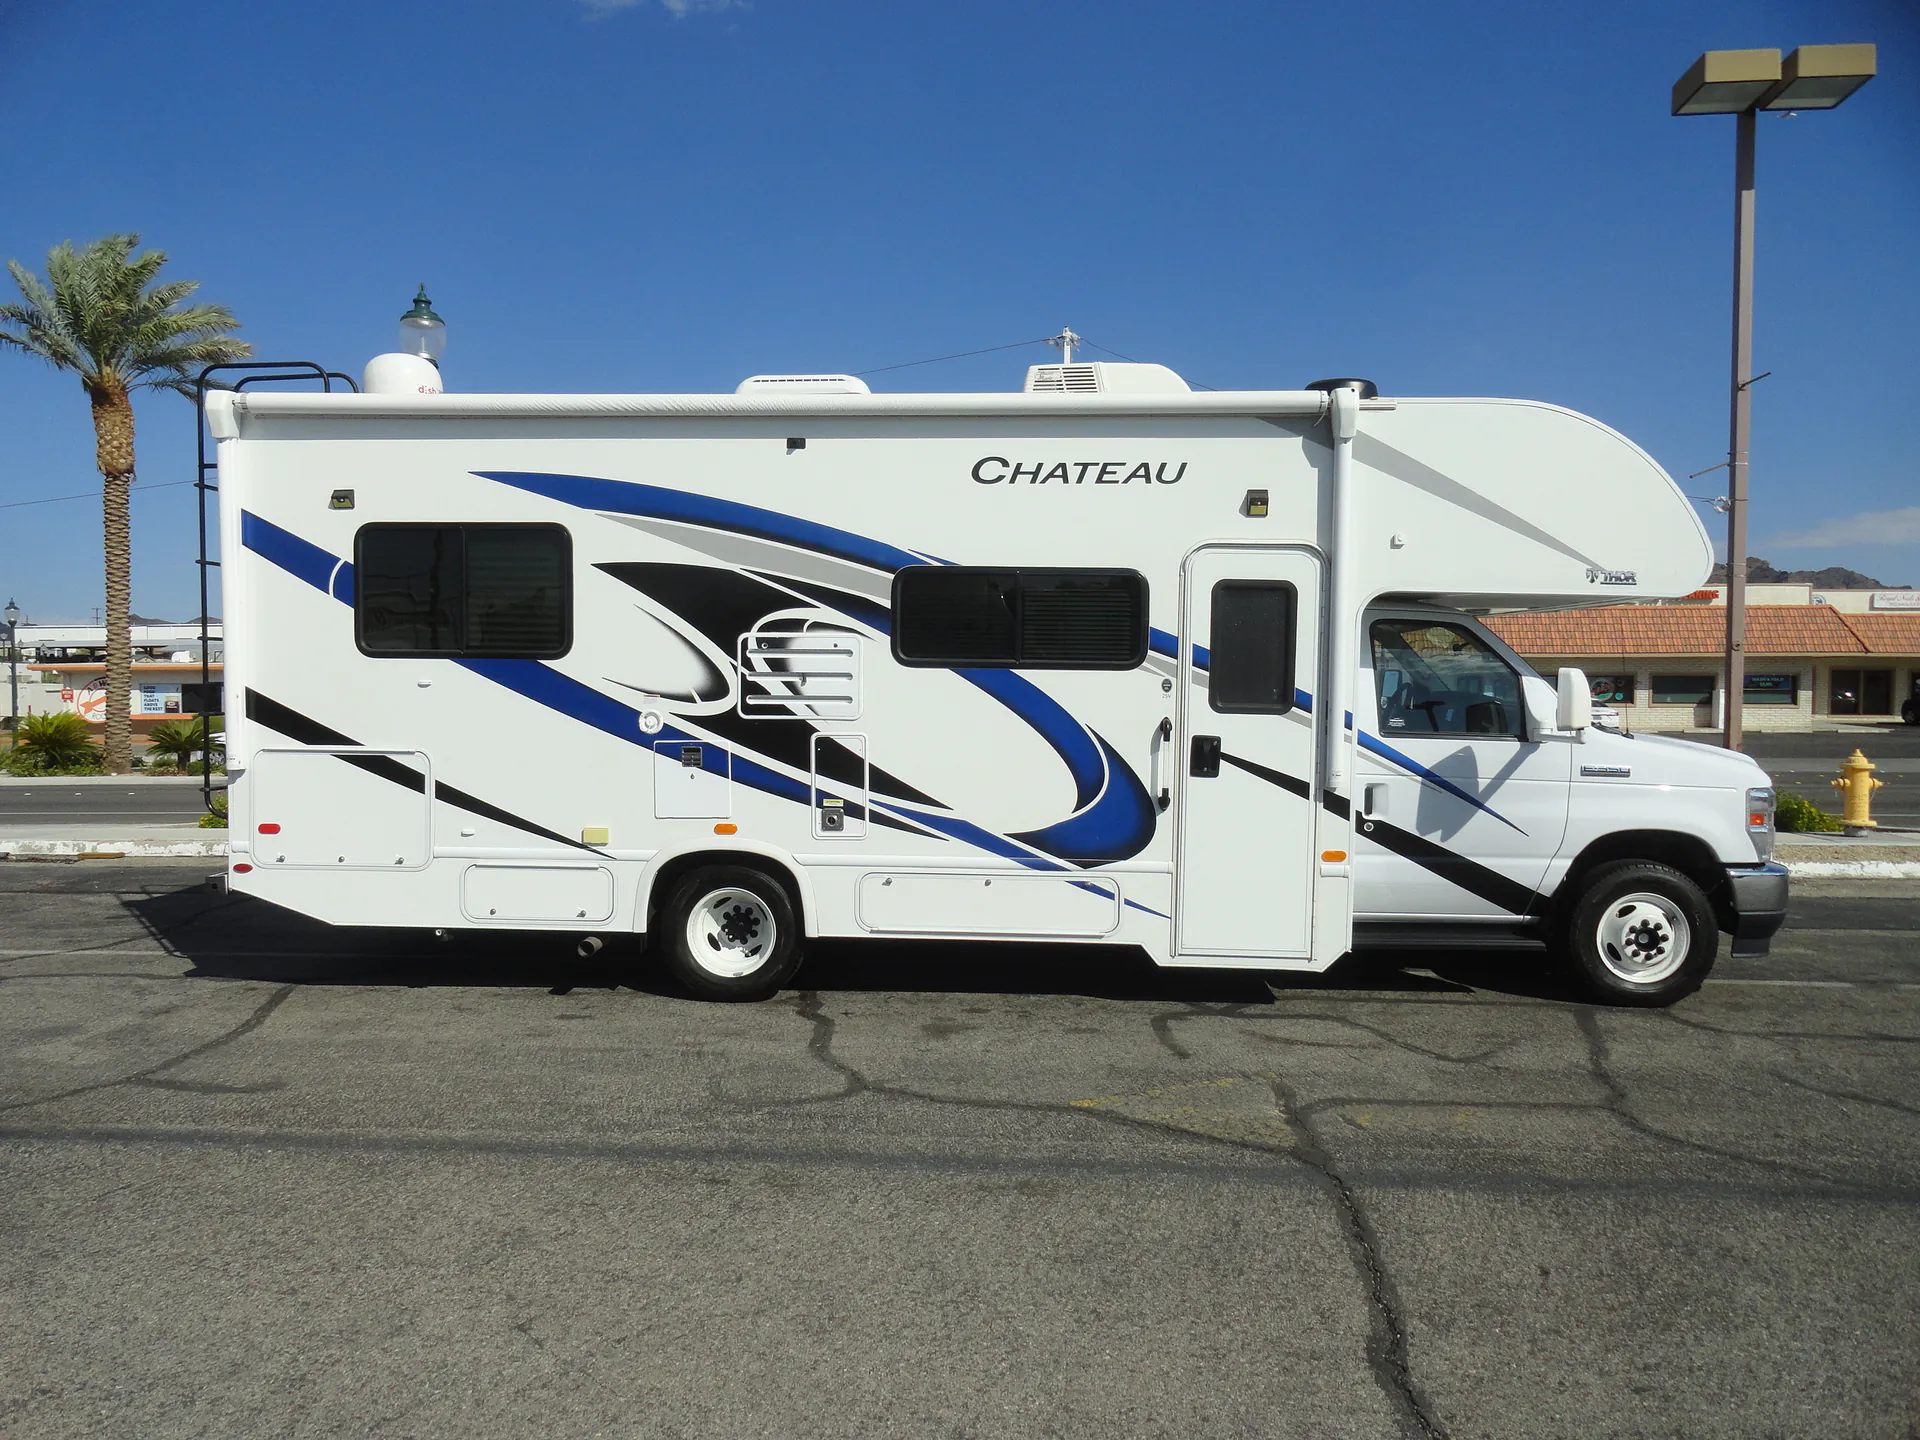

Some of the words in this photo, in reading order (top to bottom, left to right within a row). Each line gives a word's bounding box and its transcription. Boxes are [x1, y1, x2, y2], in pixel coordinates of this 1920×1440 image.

[418, 384, 437, 394] dish
[970, 456, 1188, 485] CHATEAU
[1600, 570, 1636, 582] THOR
